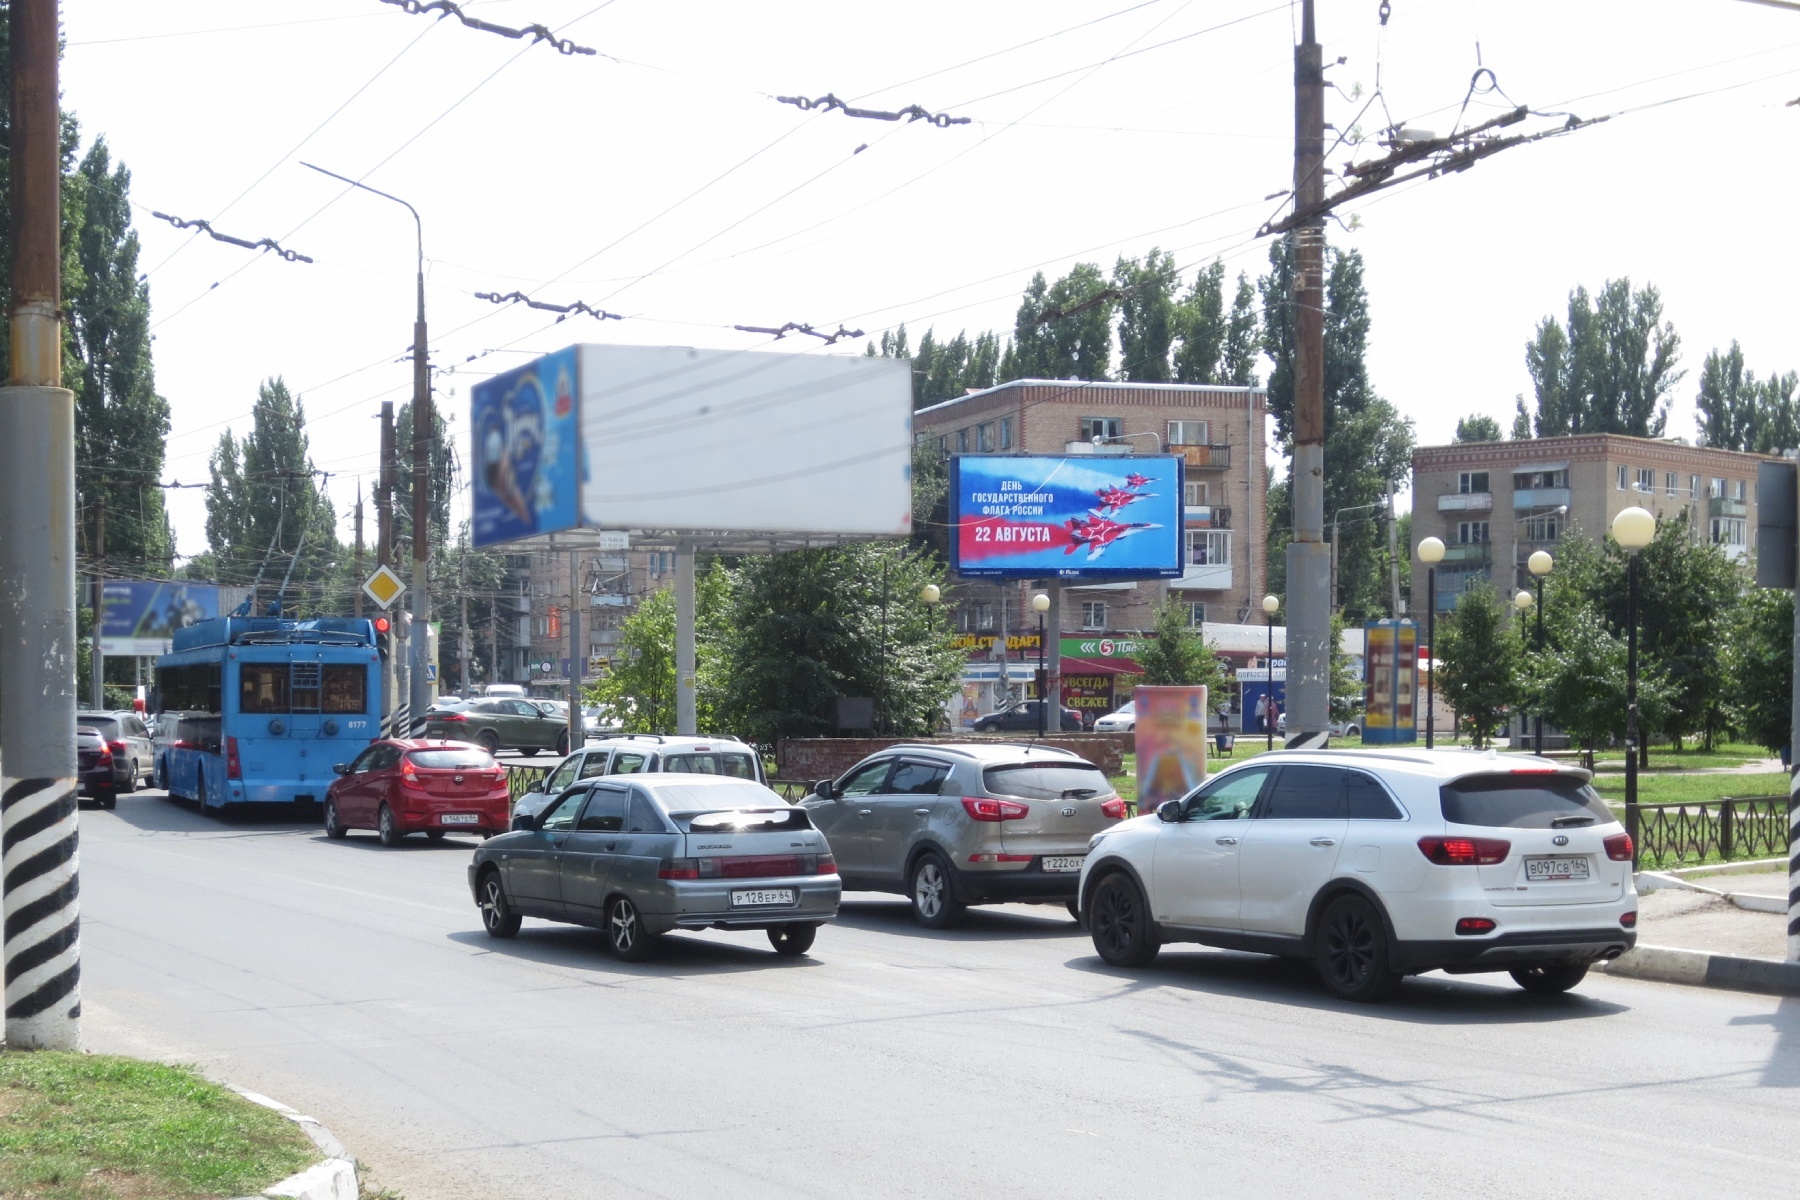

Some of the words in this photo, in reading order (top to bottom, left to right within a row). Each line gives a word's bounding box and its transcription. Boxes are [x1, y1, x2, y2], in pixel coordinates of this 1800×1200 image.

[1001, 481, 1022, 491] ДЕНЬ
[972, 493, 1054, 503] ГОСУДАРСТВЕННОГО
[982, 506, 1010, 515] ФЛАГА
[1012, 506, 1043, 515] РОССИИ
[975, 527, 991, 542] 22
[995, 527, 1050, 542] АВГУСТА
[1069, 677, 1109, 690] ВСЕГДА
[1067, 696, 1109, 708] СВЕЖЕЕ
[348, 721, 367, 729] 8177
